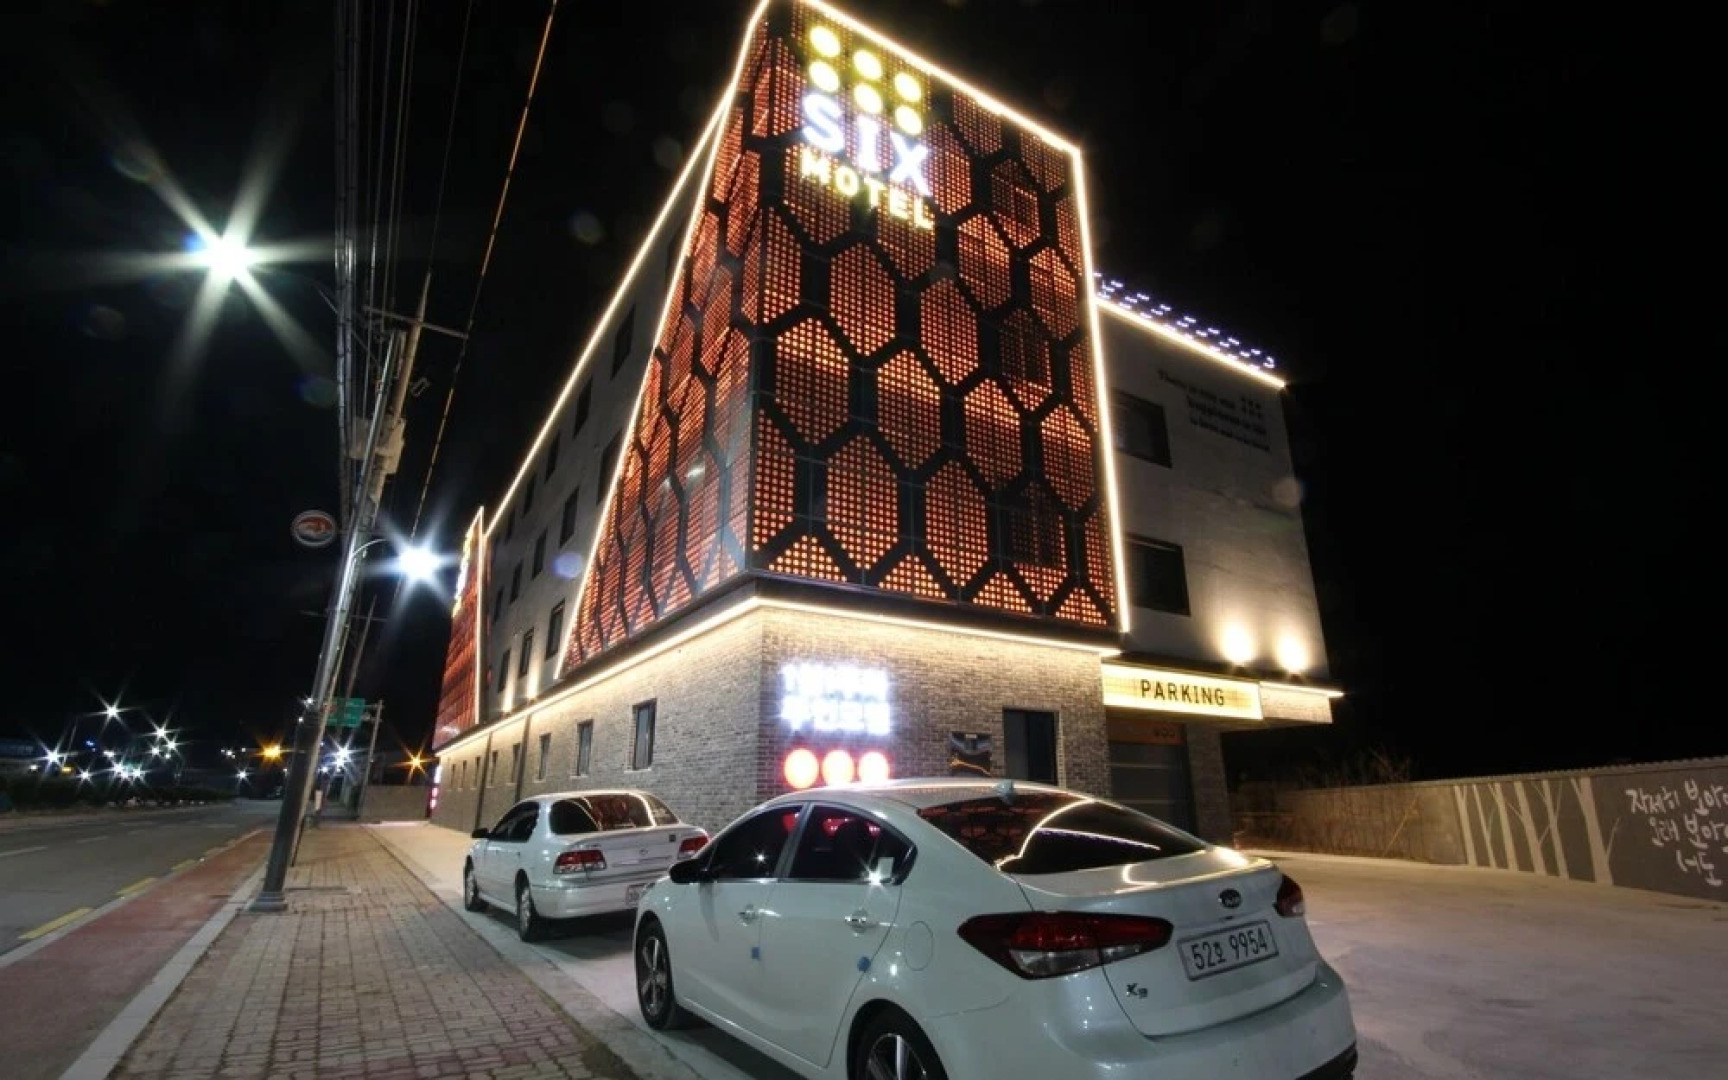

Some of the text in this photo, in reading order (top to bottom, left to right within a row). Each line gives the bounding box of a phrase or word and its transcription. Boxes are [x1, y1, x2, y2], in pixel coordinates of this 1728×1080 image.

[802, 93, 934, 197] SIX
[801, 148, 934, 230] MOTEL
[1140, 678, 1225, 706] PARKING
[1625, 786, 1680, 814] 자세히
[1683, 813, 1728, 849] 보아
[1229, 927, 1267, 960] 9954
